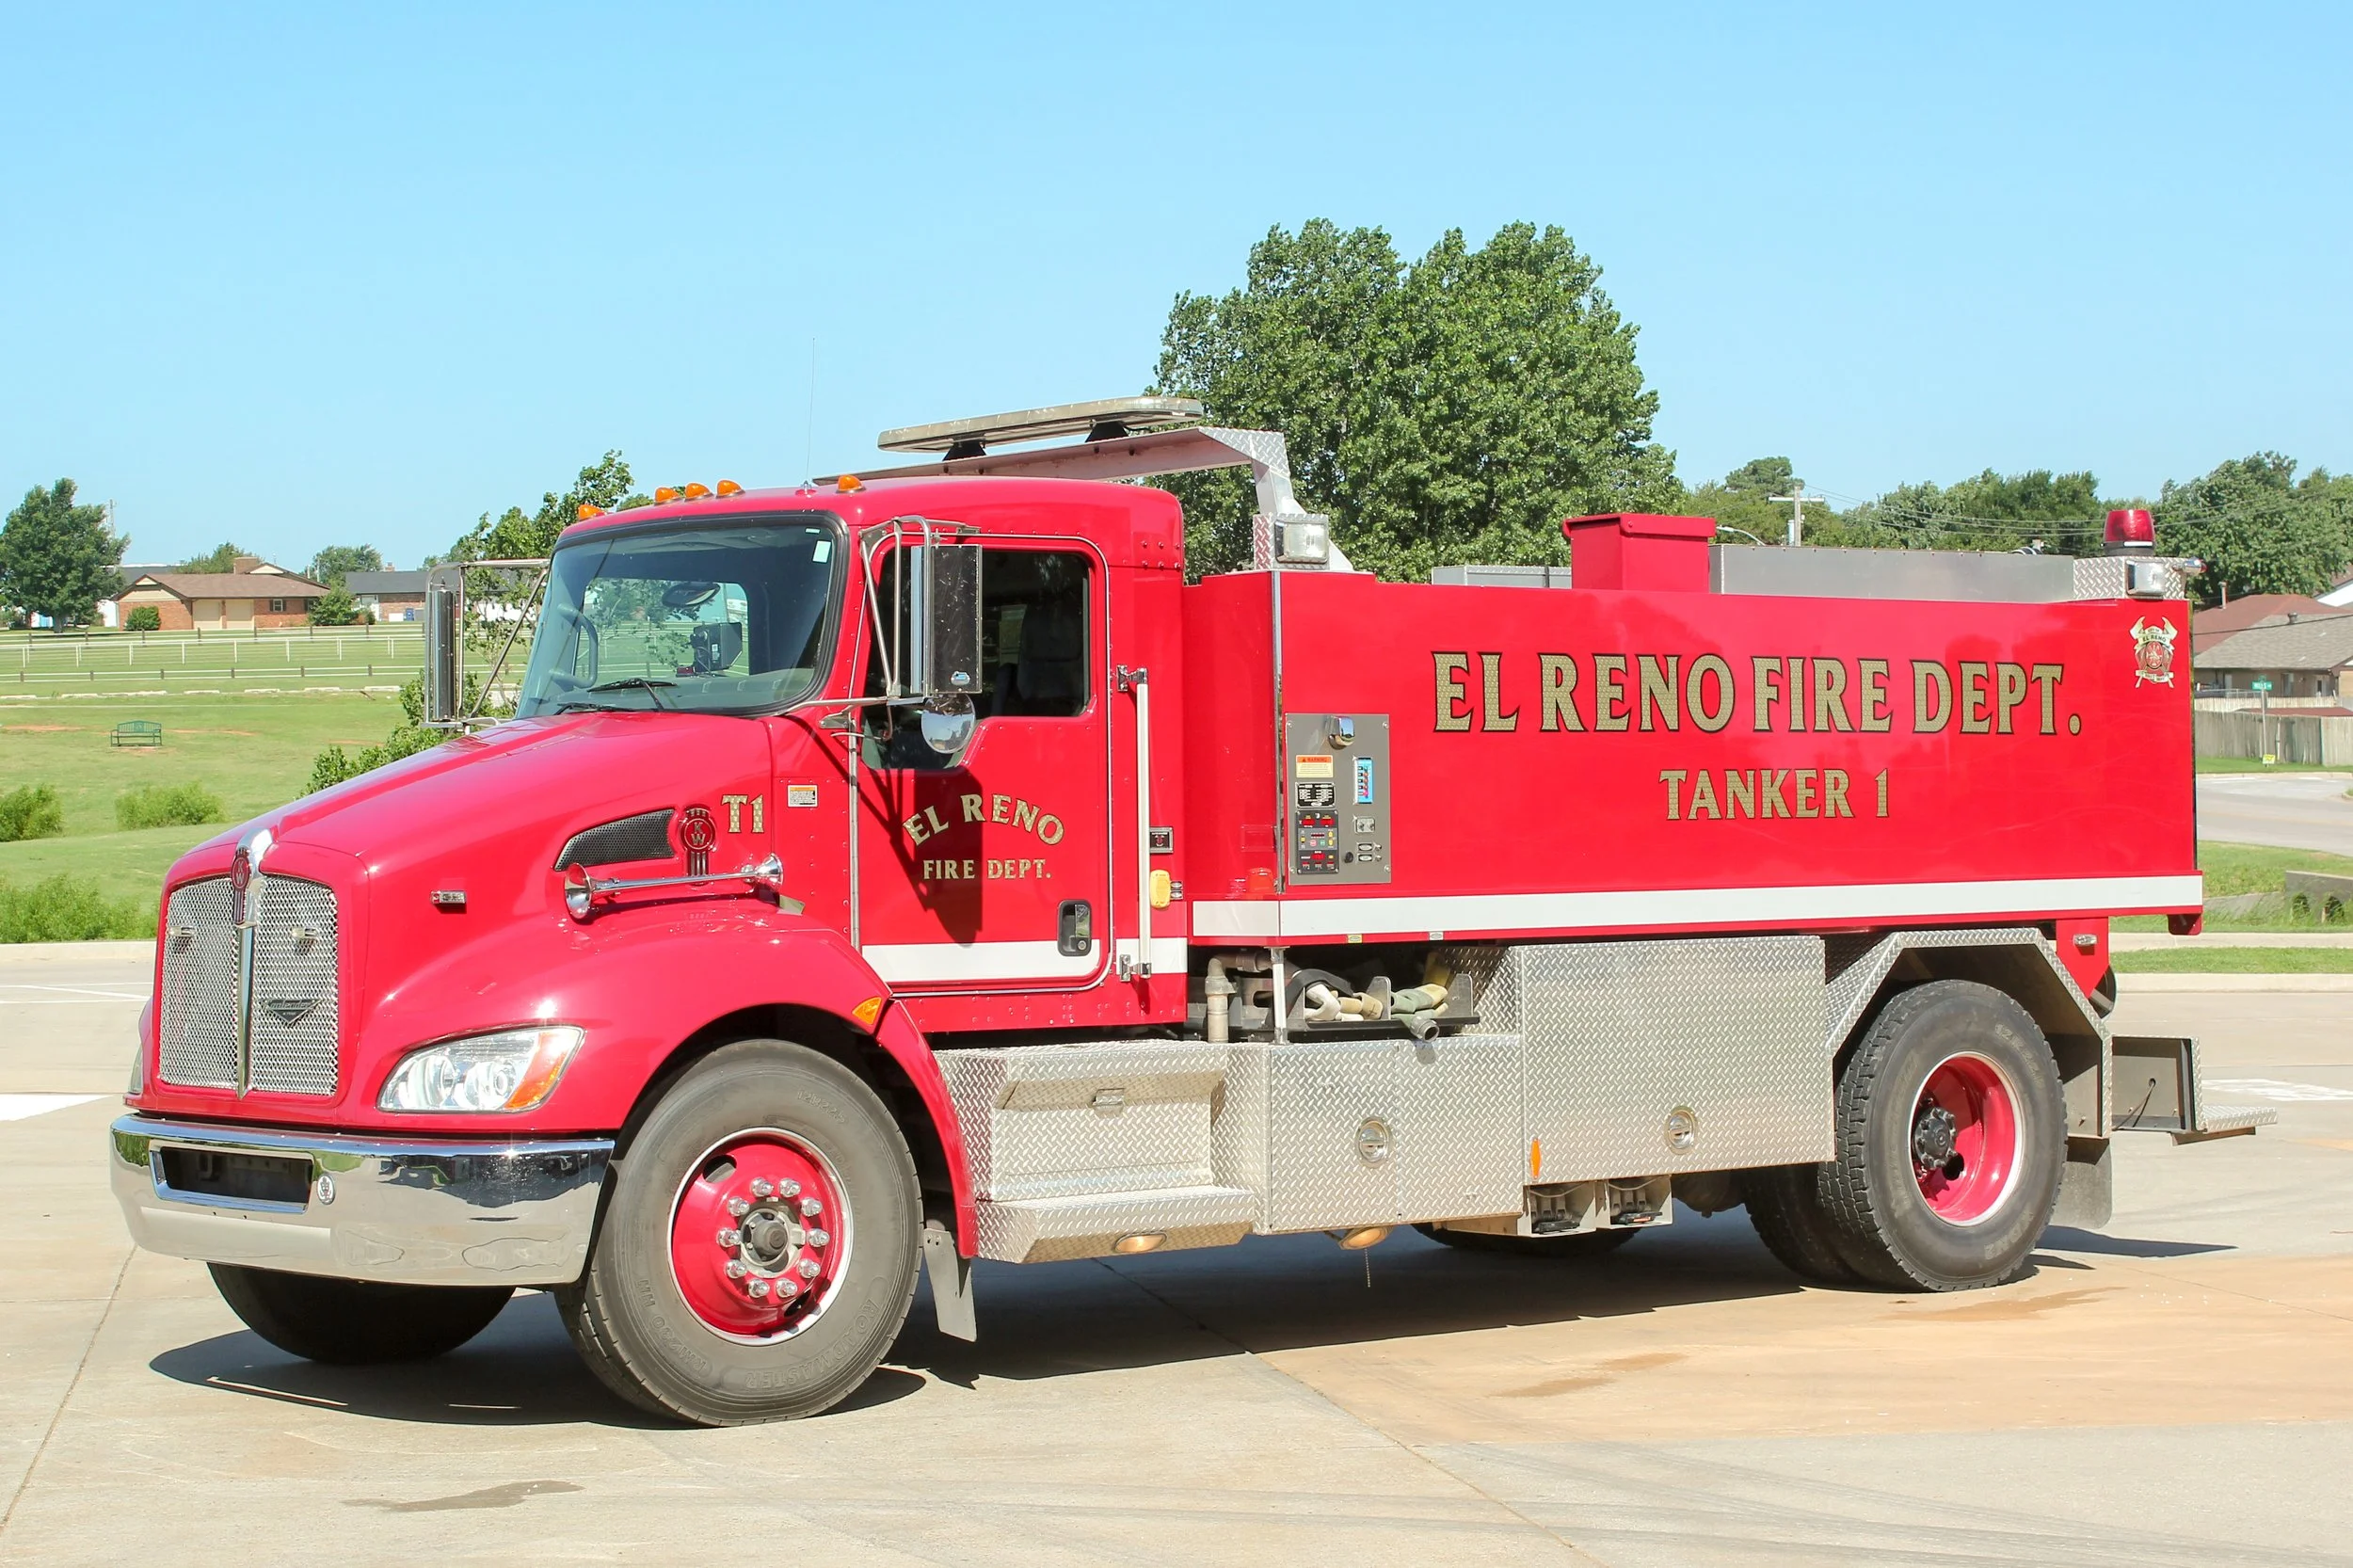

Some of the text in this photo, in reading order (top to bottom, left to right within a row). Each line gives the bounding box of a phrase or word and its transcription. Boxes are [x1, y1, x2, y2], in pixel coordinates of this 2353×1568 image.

[1431, 651, 2082, 736] EL RENO FIRE DEPT.
[721, 793, 764, 834] T1
[902, 793, 1065, 846] EL RENO
[1658, 768, 1890, 821] TANKER 1
[922, 859, 1052, 880] FIRE DEPT.
[745, 1298, 881, 1389] ROADMASTER
